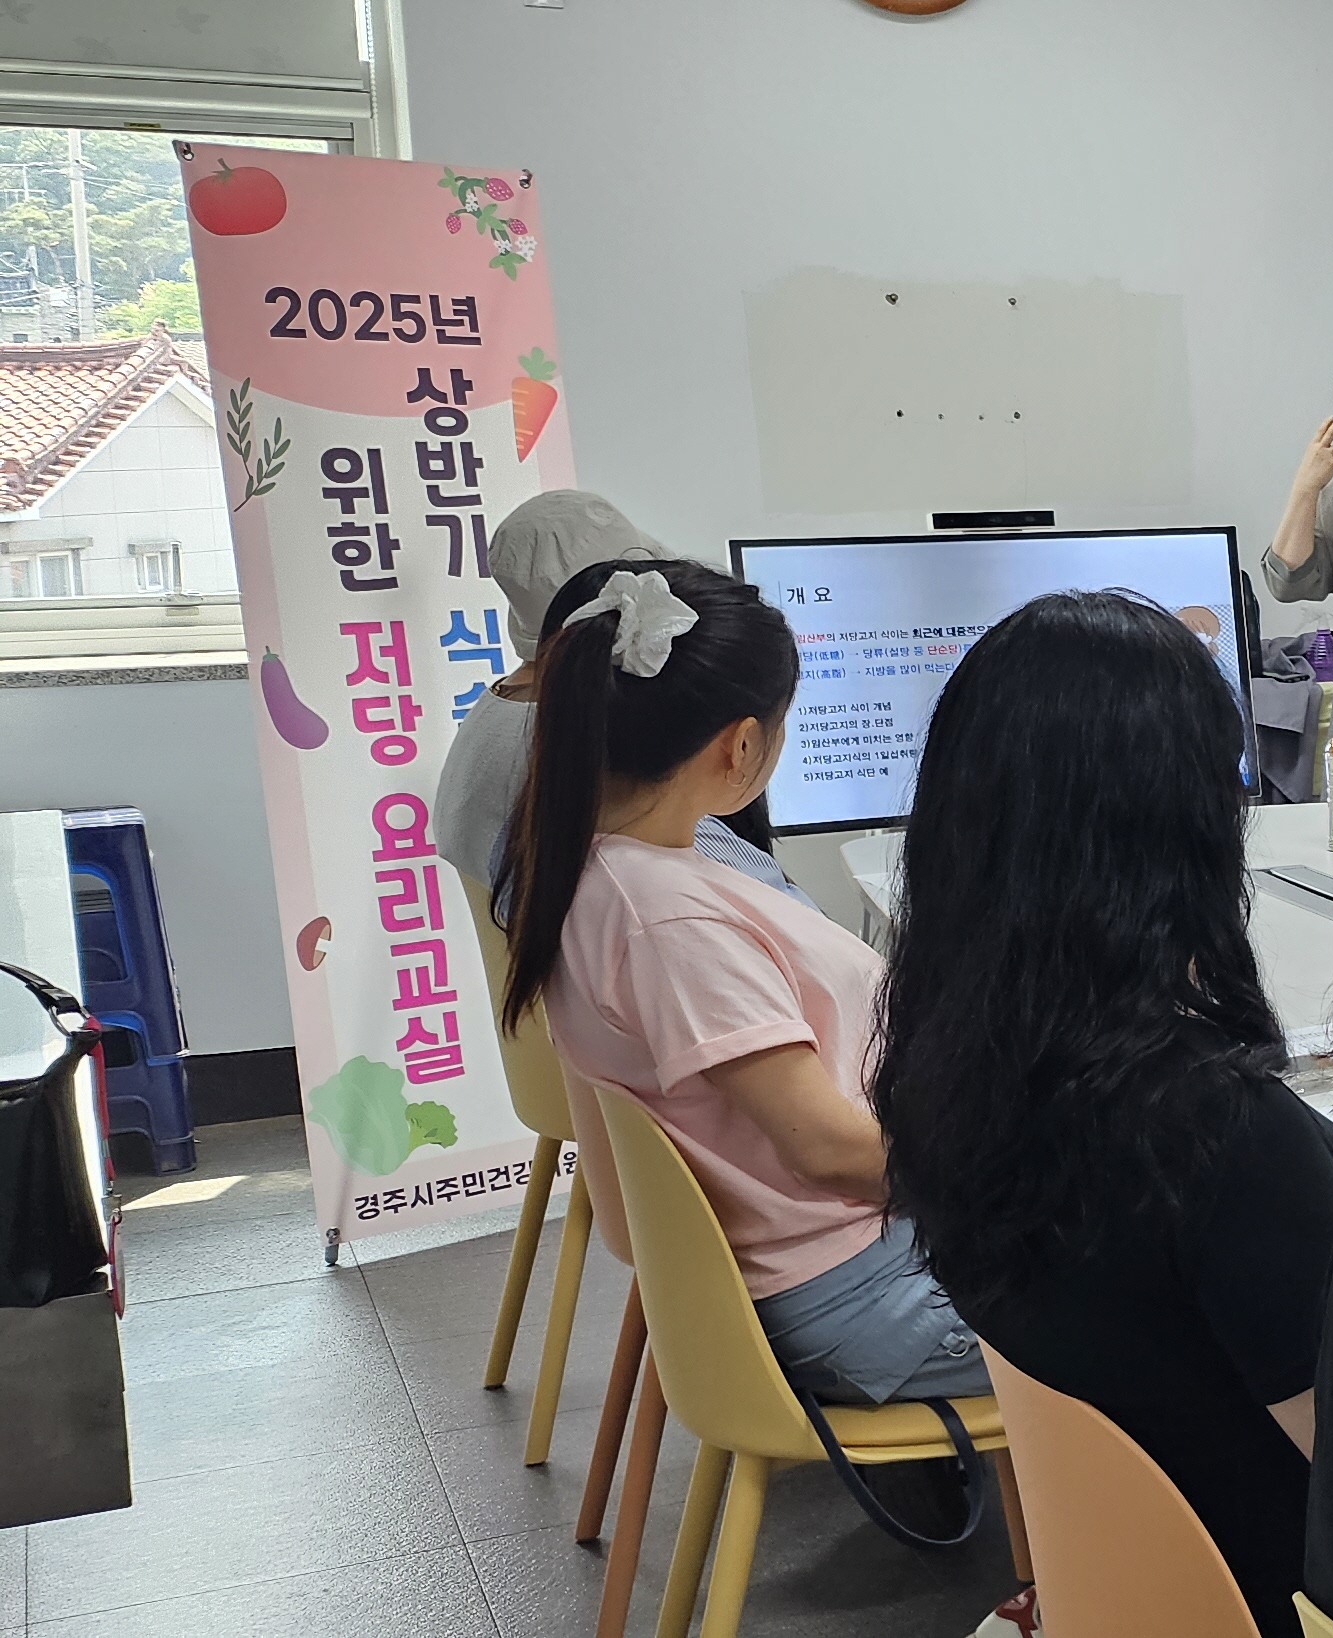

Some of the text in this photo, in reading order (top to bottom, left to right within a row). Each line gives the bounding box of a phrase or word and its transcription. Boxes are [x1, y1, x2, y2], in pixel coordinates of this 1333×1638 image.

[264, 287, 482, 346] 2025년
[407, 368, 490, 579] 상반기
[320, 447, 466, 1085] 위한 저당 요리교실
